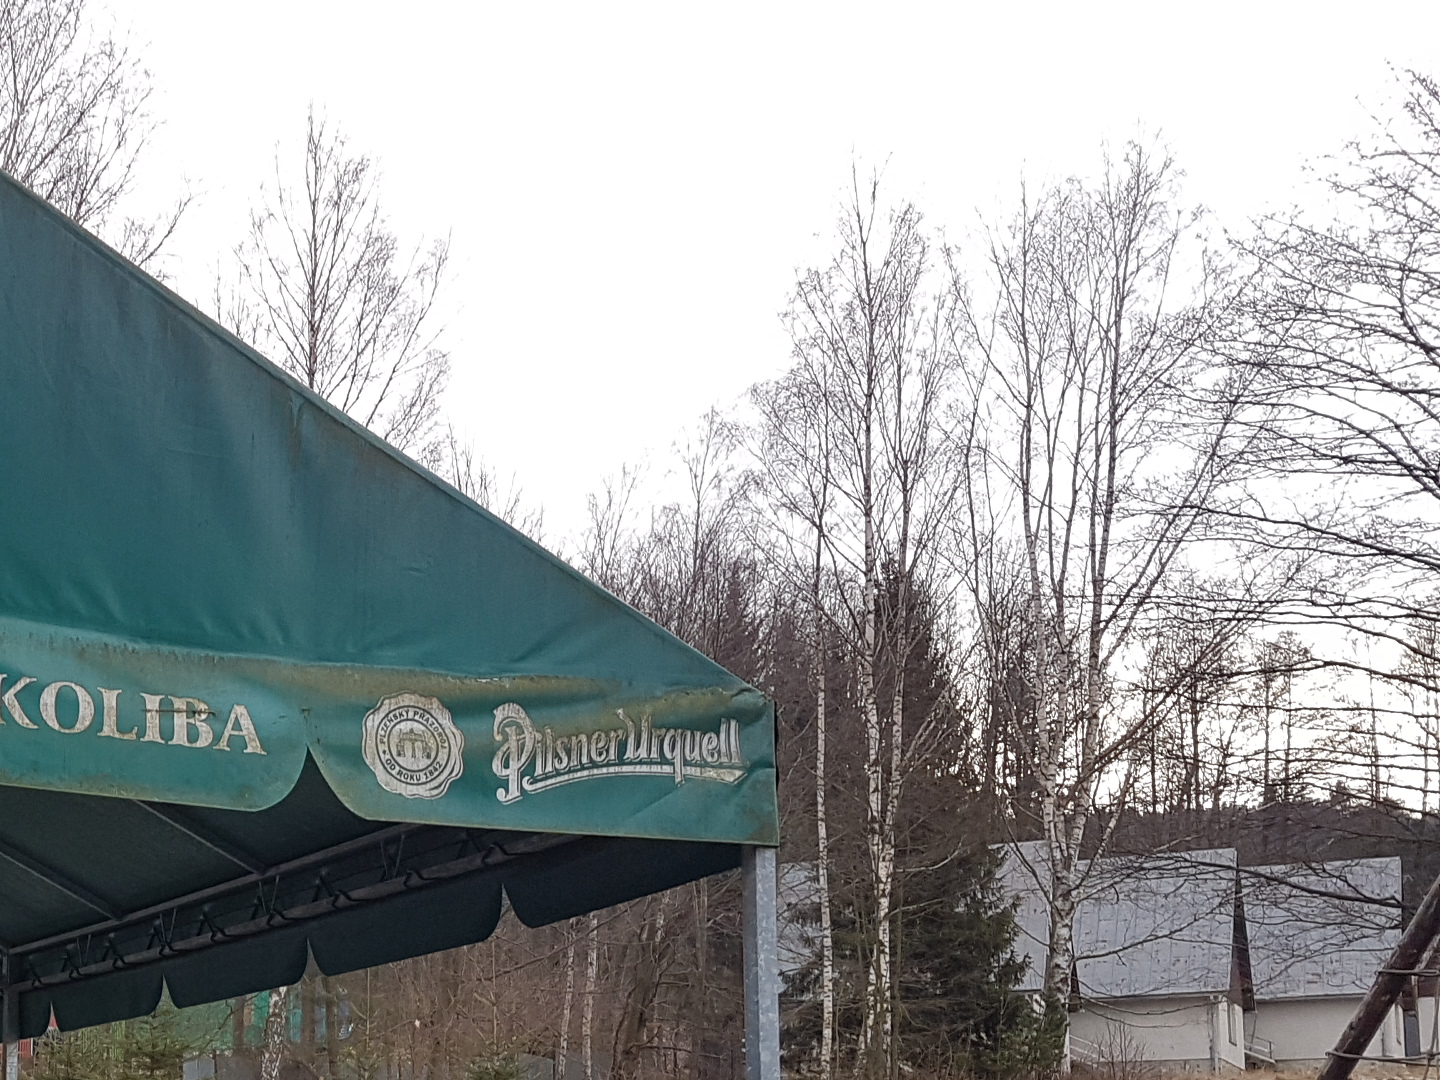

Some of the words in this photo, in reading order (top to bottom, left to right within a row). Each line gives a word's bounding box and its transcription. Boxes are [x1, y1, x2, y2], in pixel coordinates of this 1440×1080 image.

[413, 710, 447, 749] PRAZDROJ
[385, 758, 396, 771] OD
[396, 769, 421, 782] ROKU
[423, 761, 443, 780] 1842
[491, 702, 625, 806] Pilsner
[616, 707, 744, 787] Urquell
